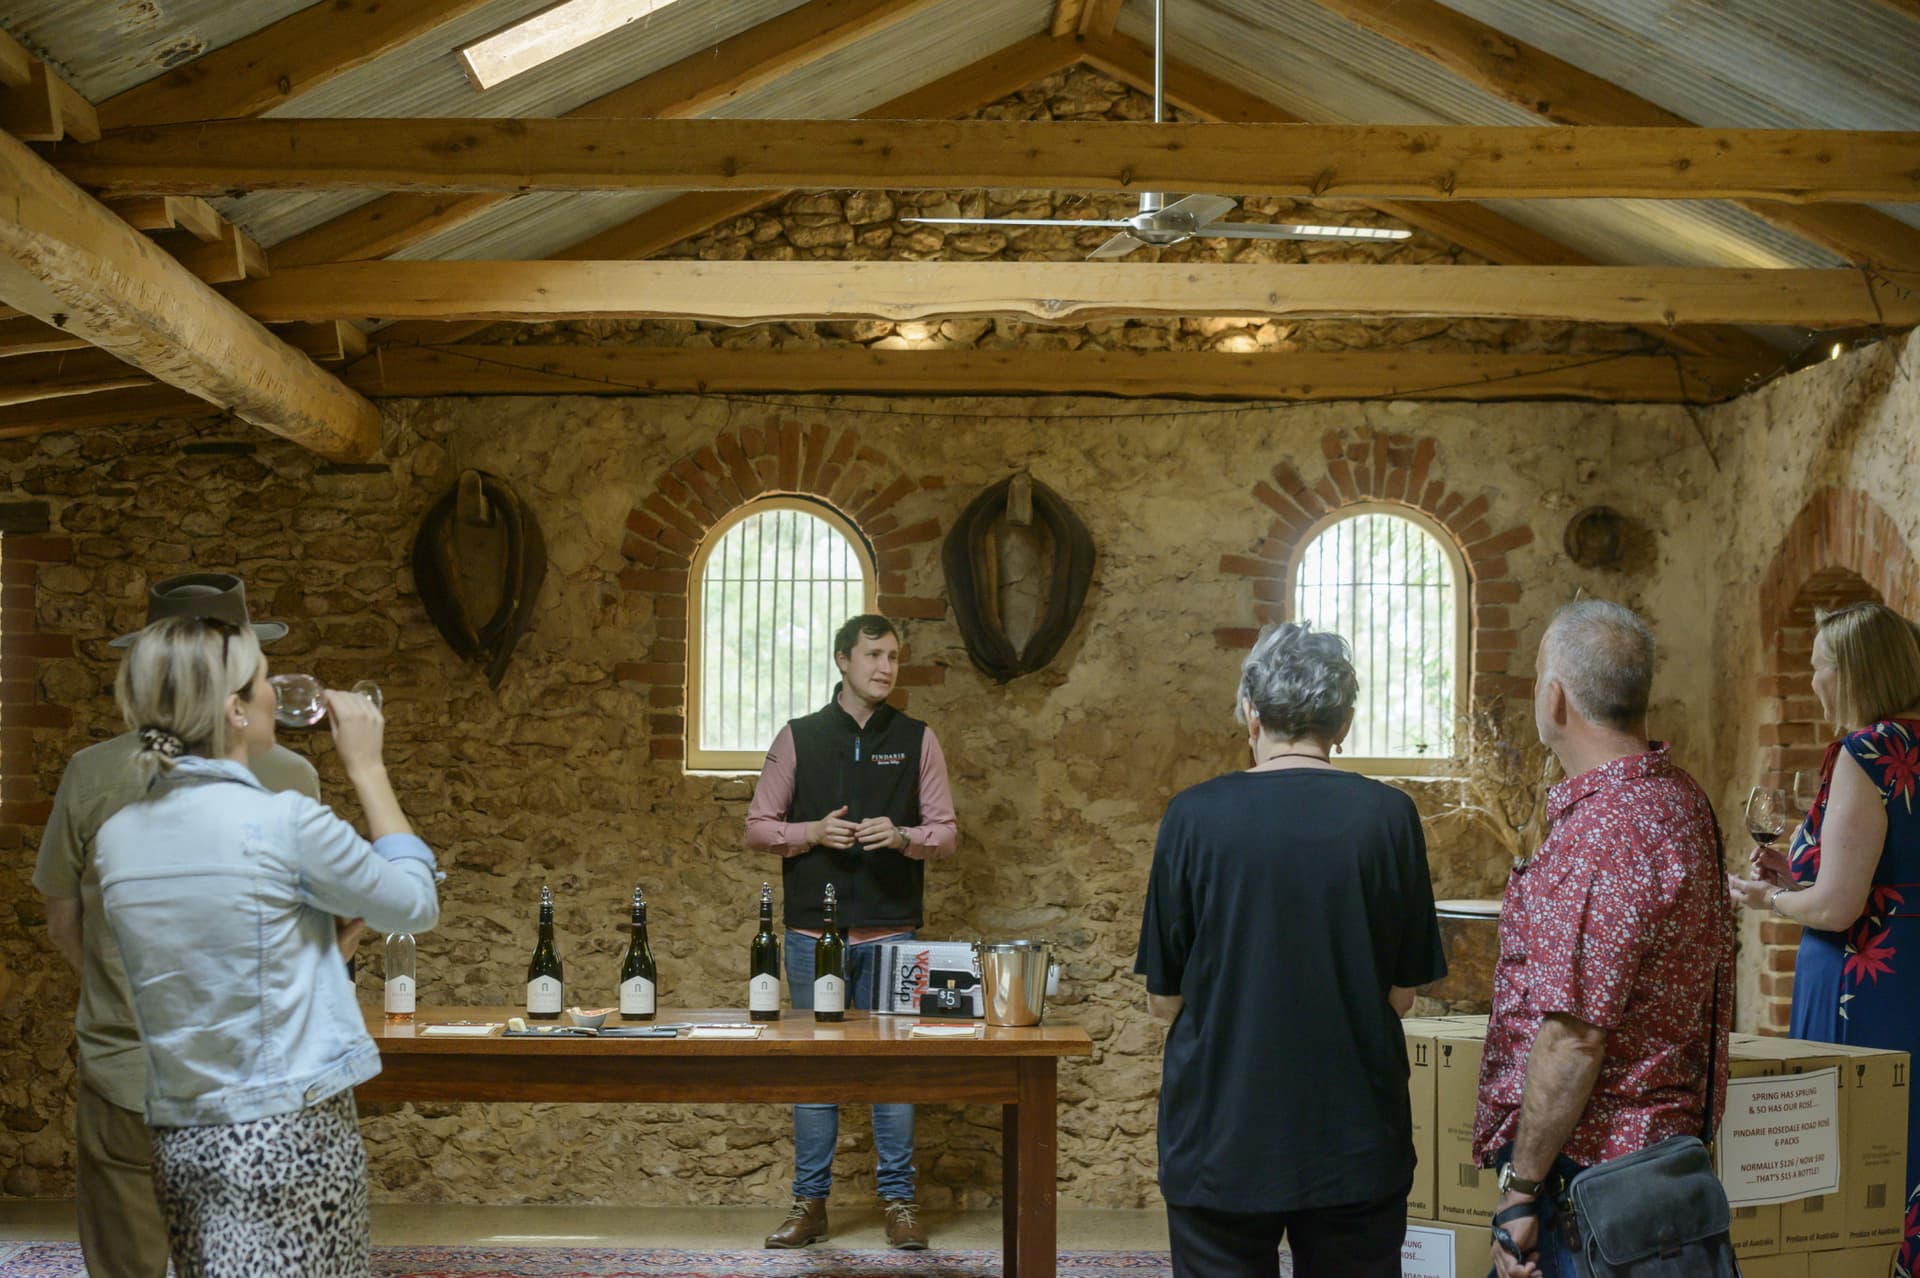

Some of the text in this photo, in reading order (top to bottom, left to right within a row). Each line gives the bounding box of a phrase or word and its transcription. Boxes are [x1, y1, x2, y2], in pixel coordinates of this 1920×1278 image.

[894, 964, 922, 1004] Slip
[912, 950, 929, 1008] WINE
[940, 991, 956, 1006] $5
[1752, 1087, 1817, 1102] SPRING HAS SPRUNG
[1748, 1106, 1755, 1114] &
[1756, 1105, 1766, 1114] SO
[1768, 1104, 1782, 1113] HAS
[1784, 1102, 1797, 1112] OUR
[1733, 1128, 1766, 1138] PINDARIE
[1768, 1124, 1800, 1136] ROSEDALE
[1801, 1120, 1816, 1130] ROAD
[1780, 1136, 1799, 1146] PACKS
[1740, 1161, 1778, 1172] NORMALLY
[1800, 1156, 1813, 1164] NOW
[1781, 1172, 1791, 1181] $15
[1466, 1207, 1472, 1215] of
